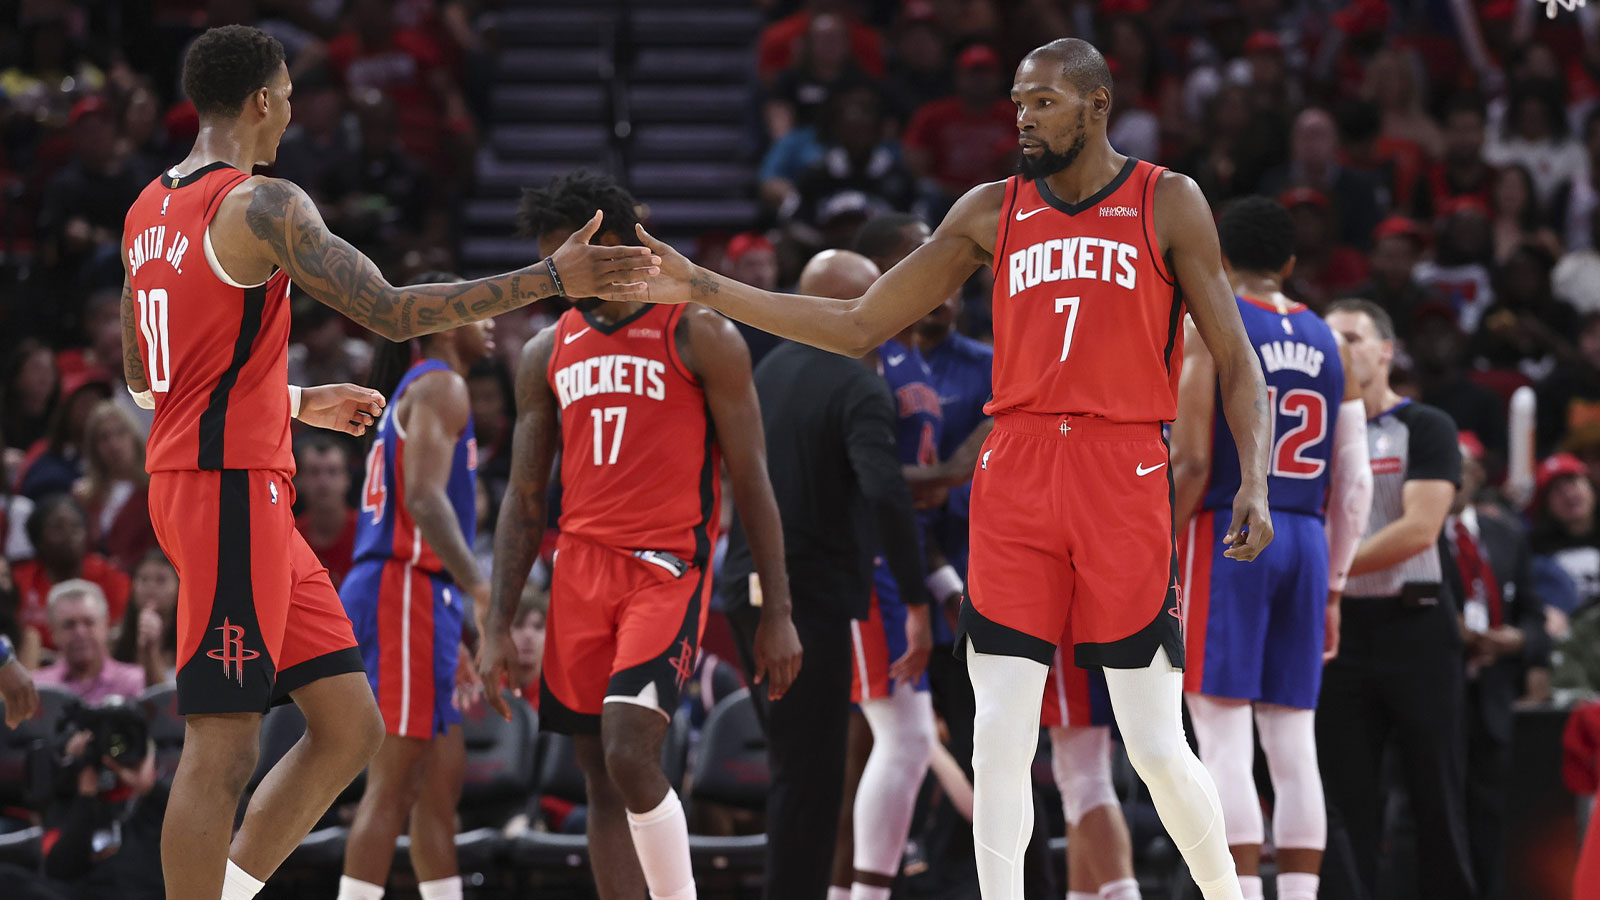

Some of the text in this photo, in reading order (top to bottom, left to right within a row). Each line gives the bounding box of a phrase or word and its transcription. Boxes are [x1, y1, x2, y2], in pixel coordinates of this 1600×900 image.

[128, 225, 189, 277] SMITH JR.
[1008, 236, 1138, 299] ROCKETS
[137, 288, 170, 393] 10
[1054, 296, 1080, 363] 7
[1259, 340, 1325, 378] HARRIS
[554, 354, 666, 410] ROCKETS
[590, 406, 628, 466] 17
